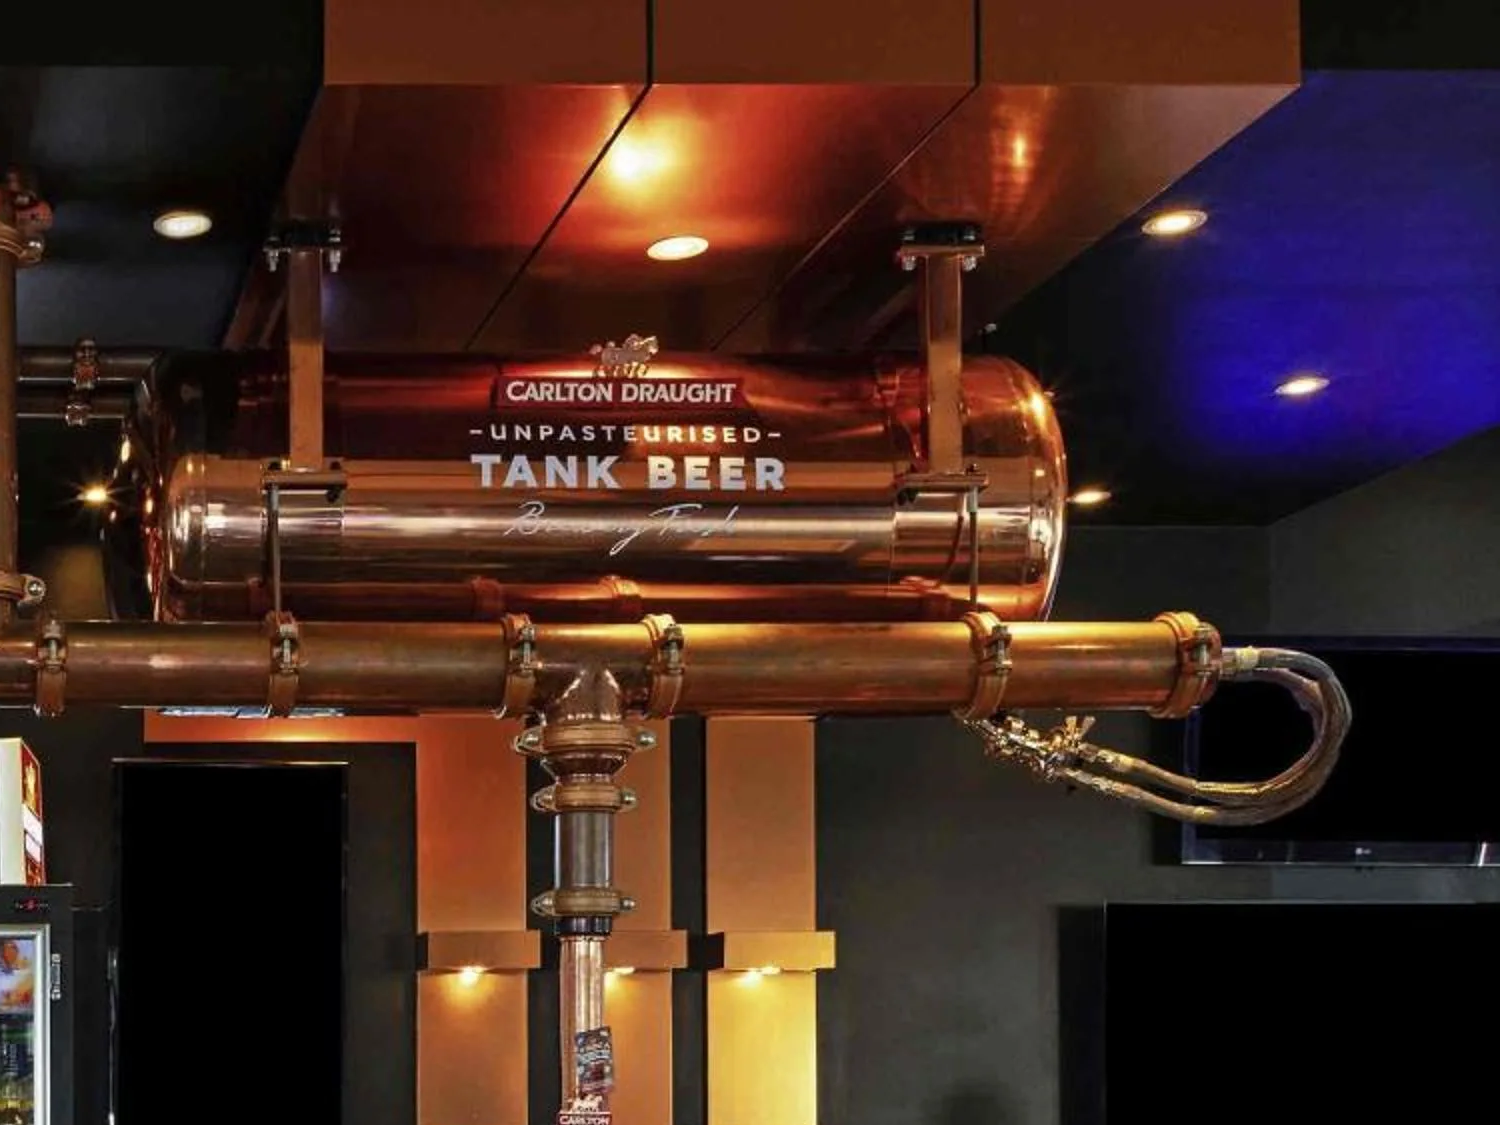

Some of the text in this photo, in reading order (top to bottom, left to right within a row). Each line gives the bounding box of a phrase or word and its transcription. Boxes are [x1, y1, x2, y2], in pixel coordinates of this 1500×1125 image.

[506, 380, 737, 404] CARLTON DRAUGHT
[471, 453, 787, 491] TANK BEER
[560, 1114, 609, 1125] CARLTON
